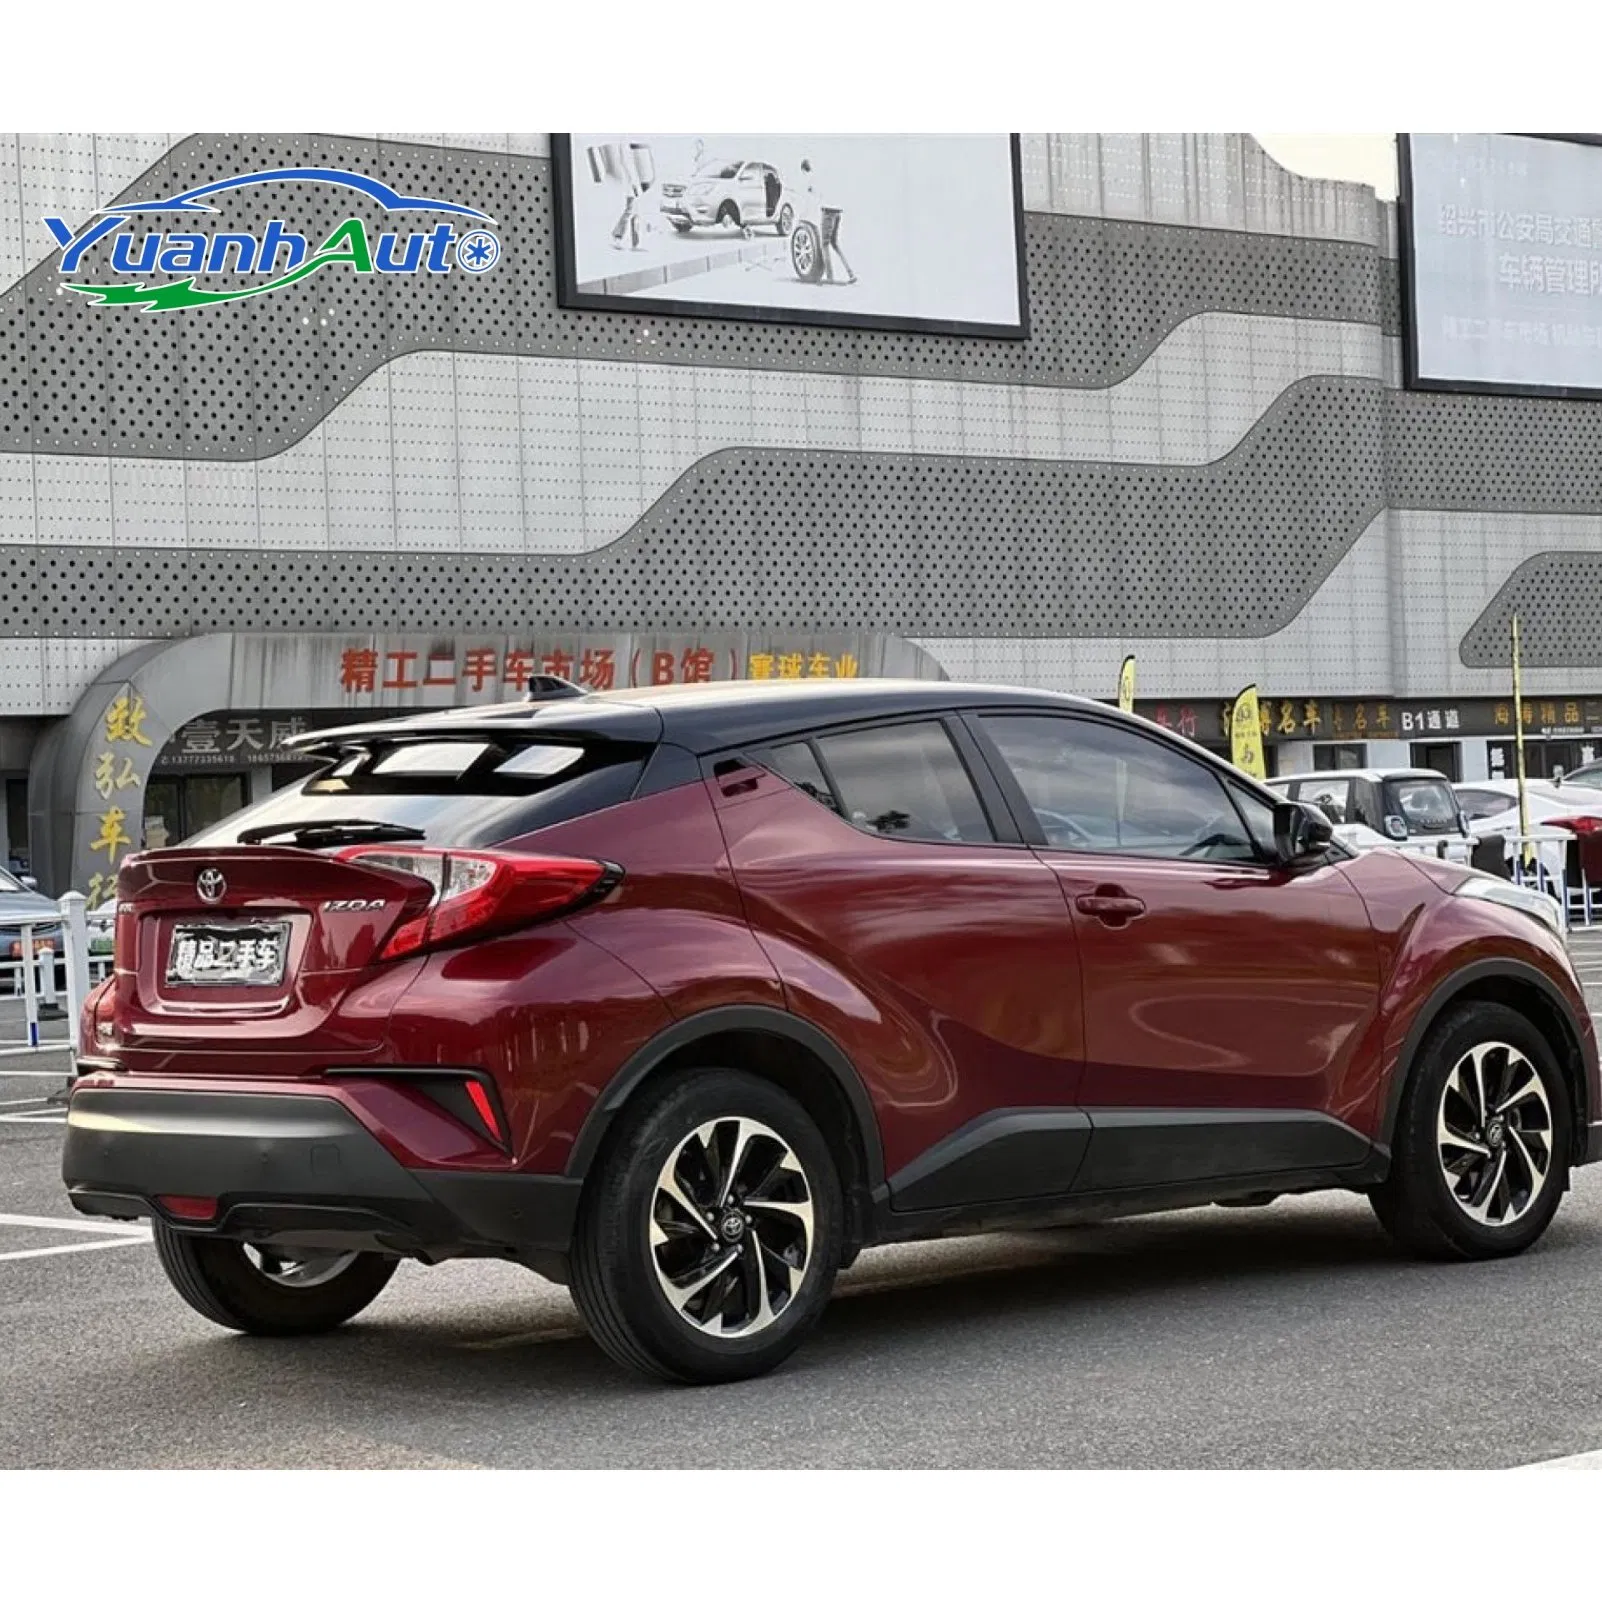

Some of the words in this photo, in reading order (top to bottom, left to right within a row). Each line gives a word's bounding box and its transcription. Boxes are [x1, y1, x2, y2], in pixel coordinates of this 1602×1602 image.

[1401, 708, 1460, 731] B1通道
[170, 716, 308, 754] 壹天威
[323, 899, 386, 912] IZOA
